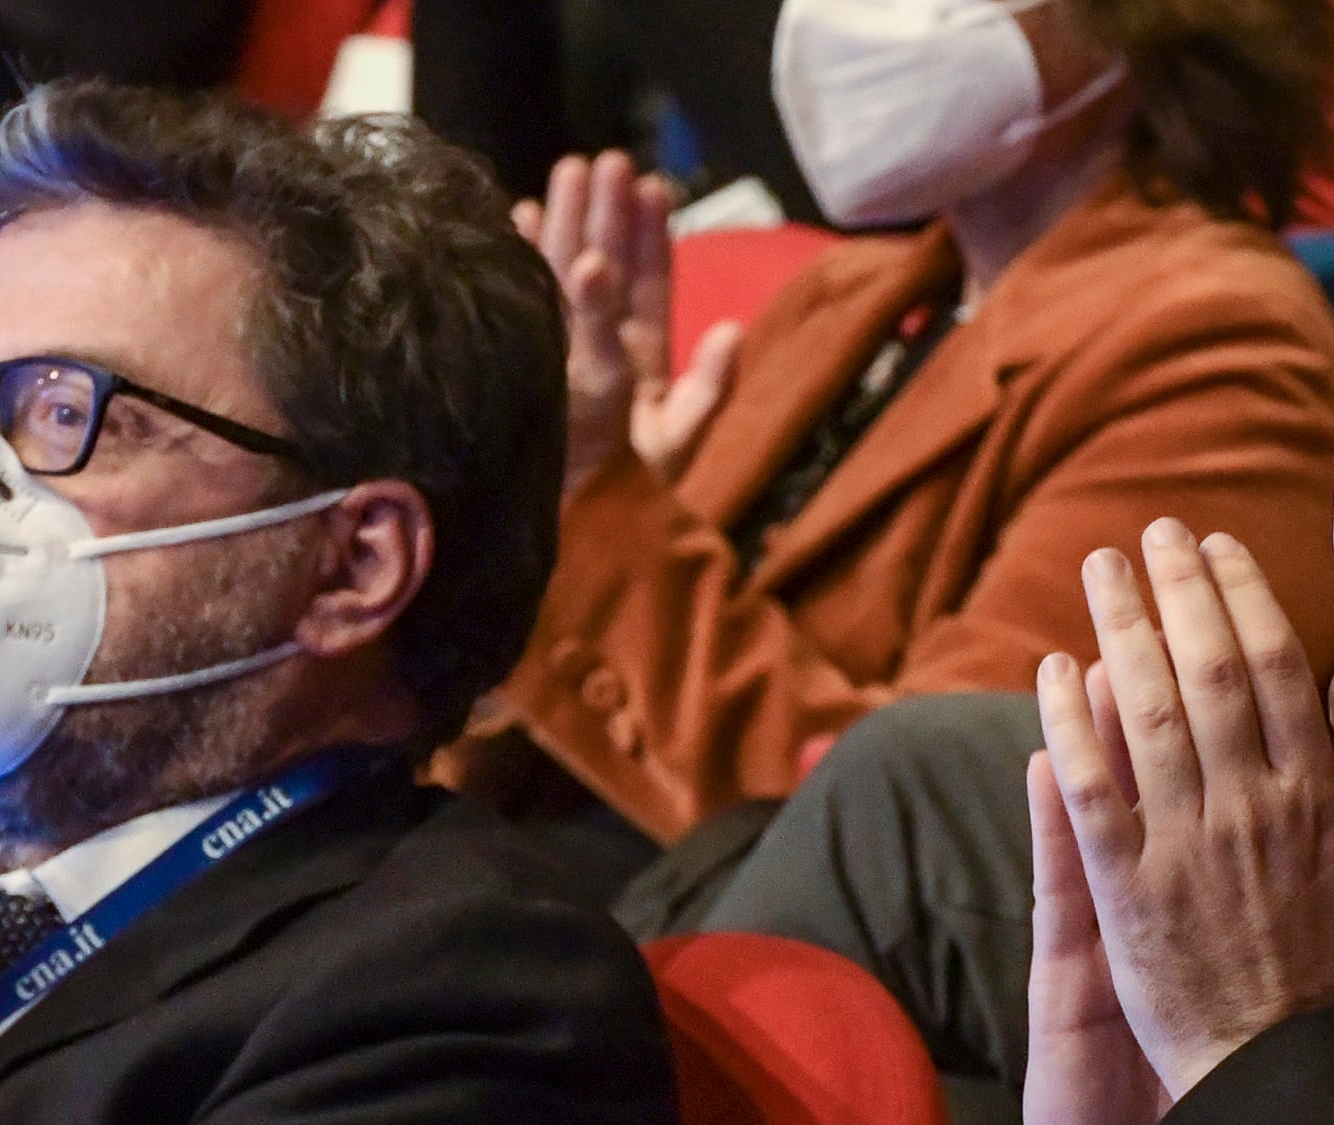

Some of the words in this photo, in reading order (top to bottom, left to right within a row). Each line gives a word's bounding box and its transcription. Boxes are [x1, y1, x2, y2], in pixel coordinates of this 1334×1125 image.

[5, 621, 55, 642] KN95
[201, 785, 293, 859] cna.it
[15, 922, 106, 1001] cna.it
